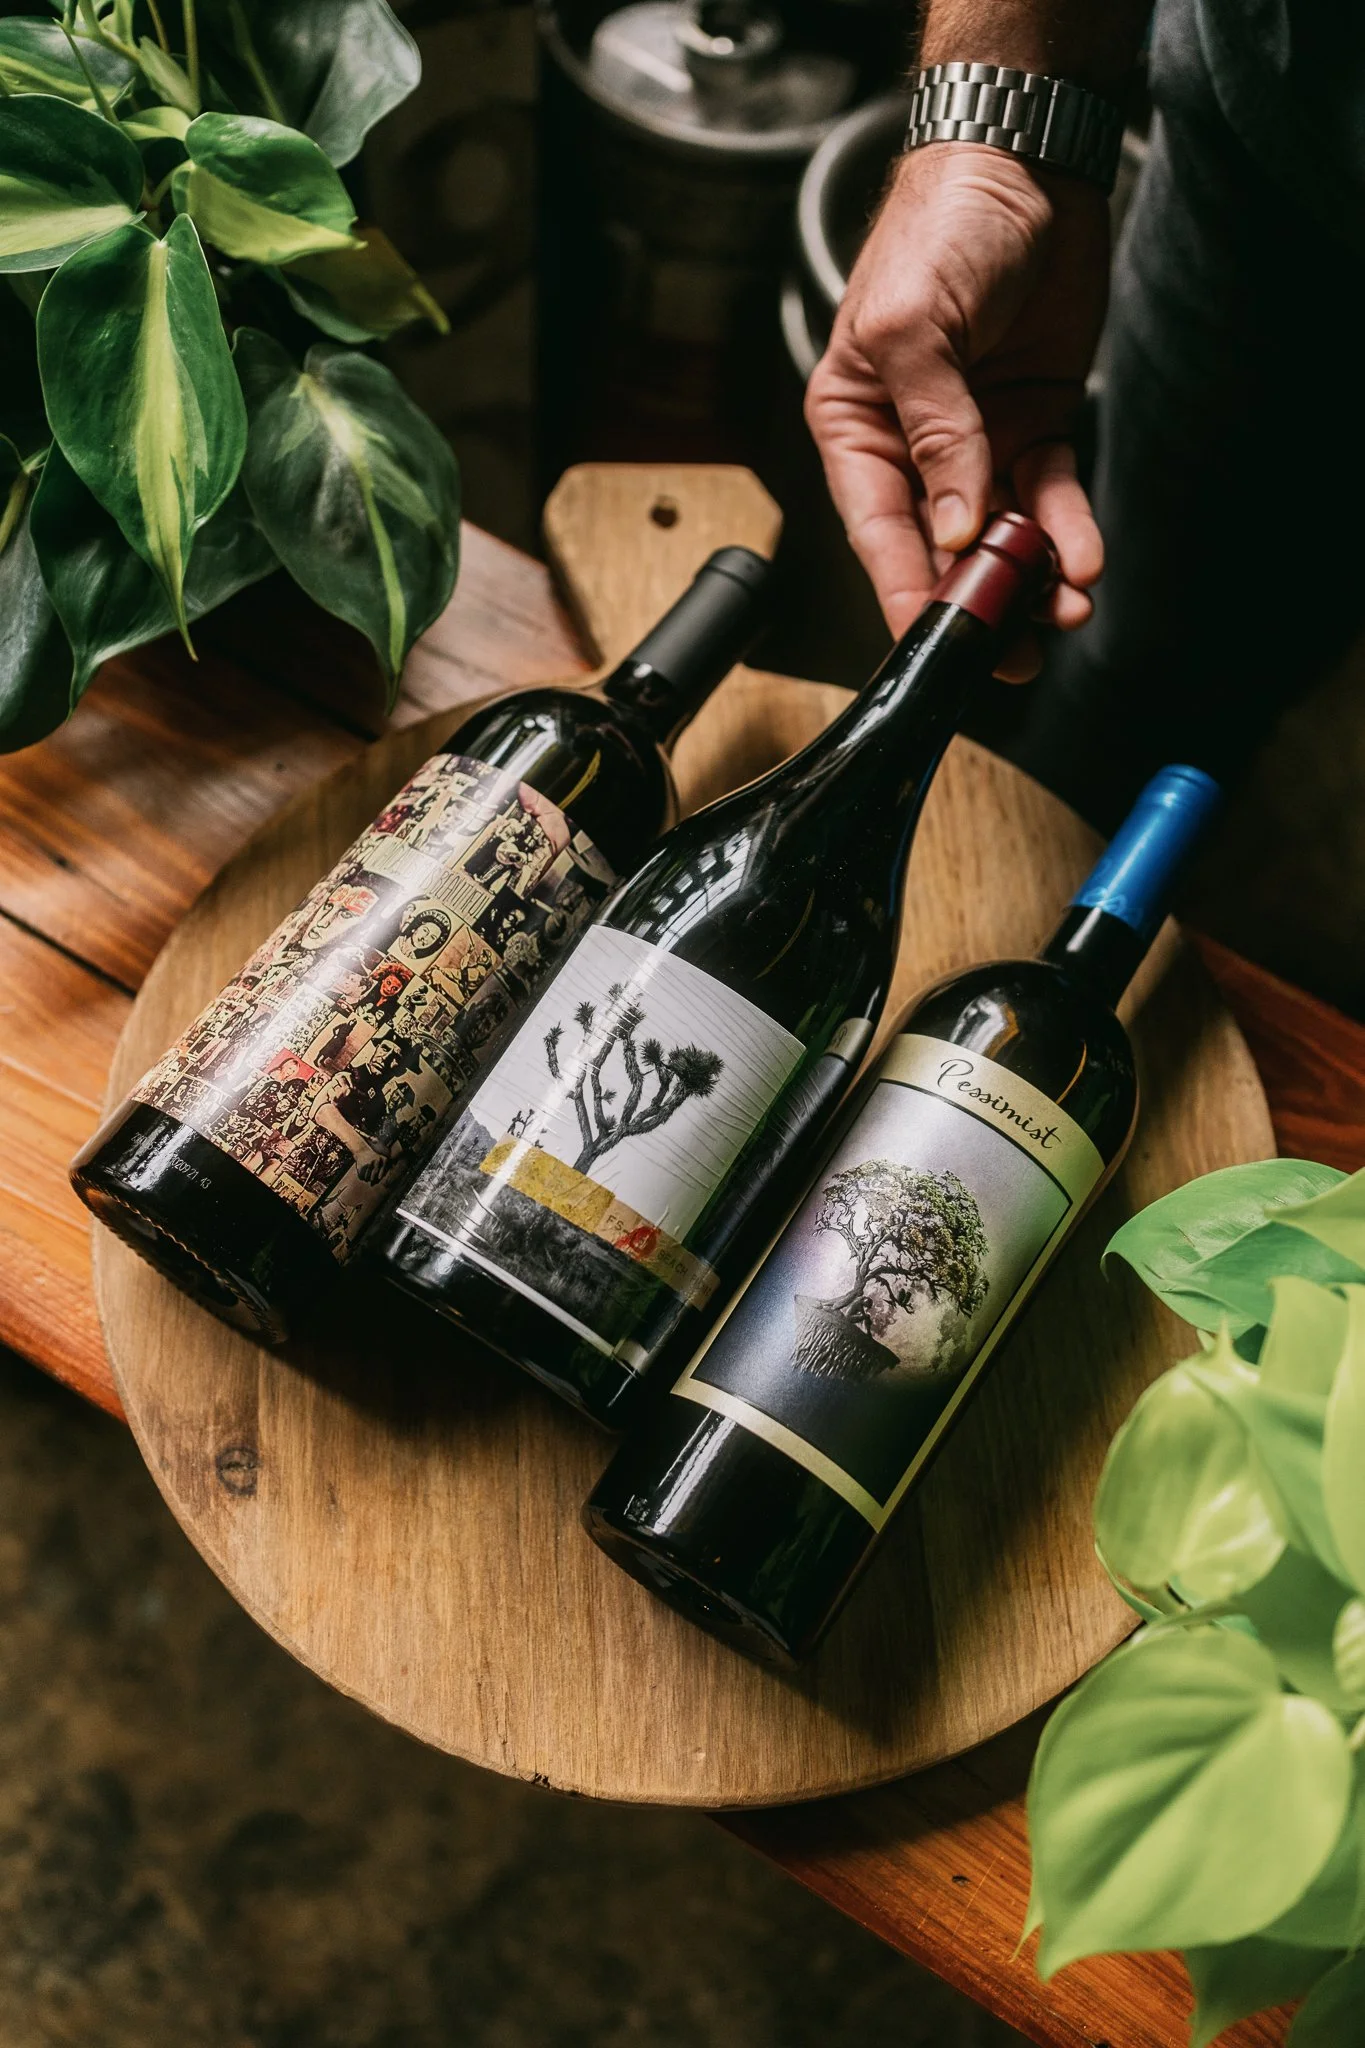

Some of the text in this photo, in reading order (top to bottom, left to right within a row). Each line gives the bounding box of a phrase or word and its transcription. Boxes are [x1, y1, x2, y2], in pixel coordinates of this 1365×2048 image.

[432, 870, 490, 919] BEAUTIFUL
[937, 1058, 1063, 1149] Pessimist
[658, 1249, 688, 1276] BEACH
